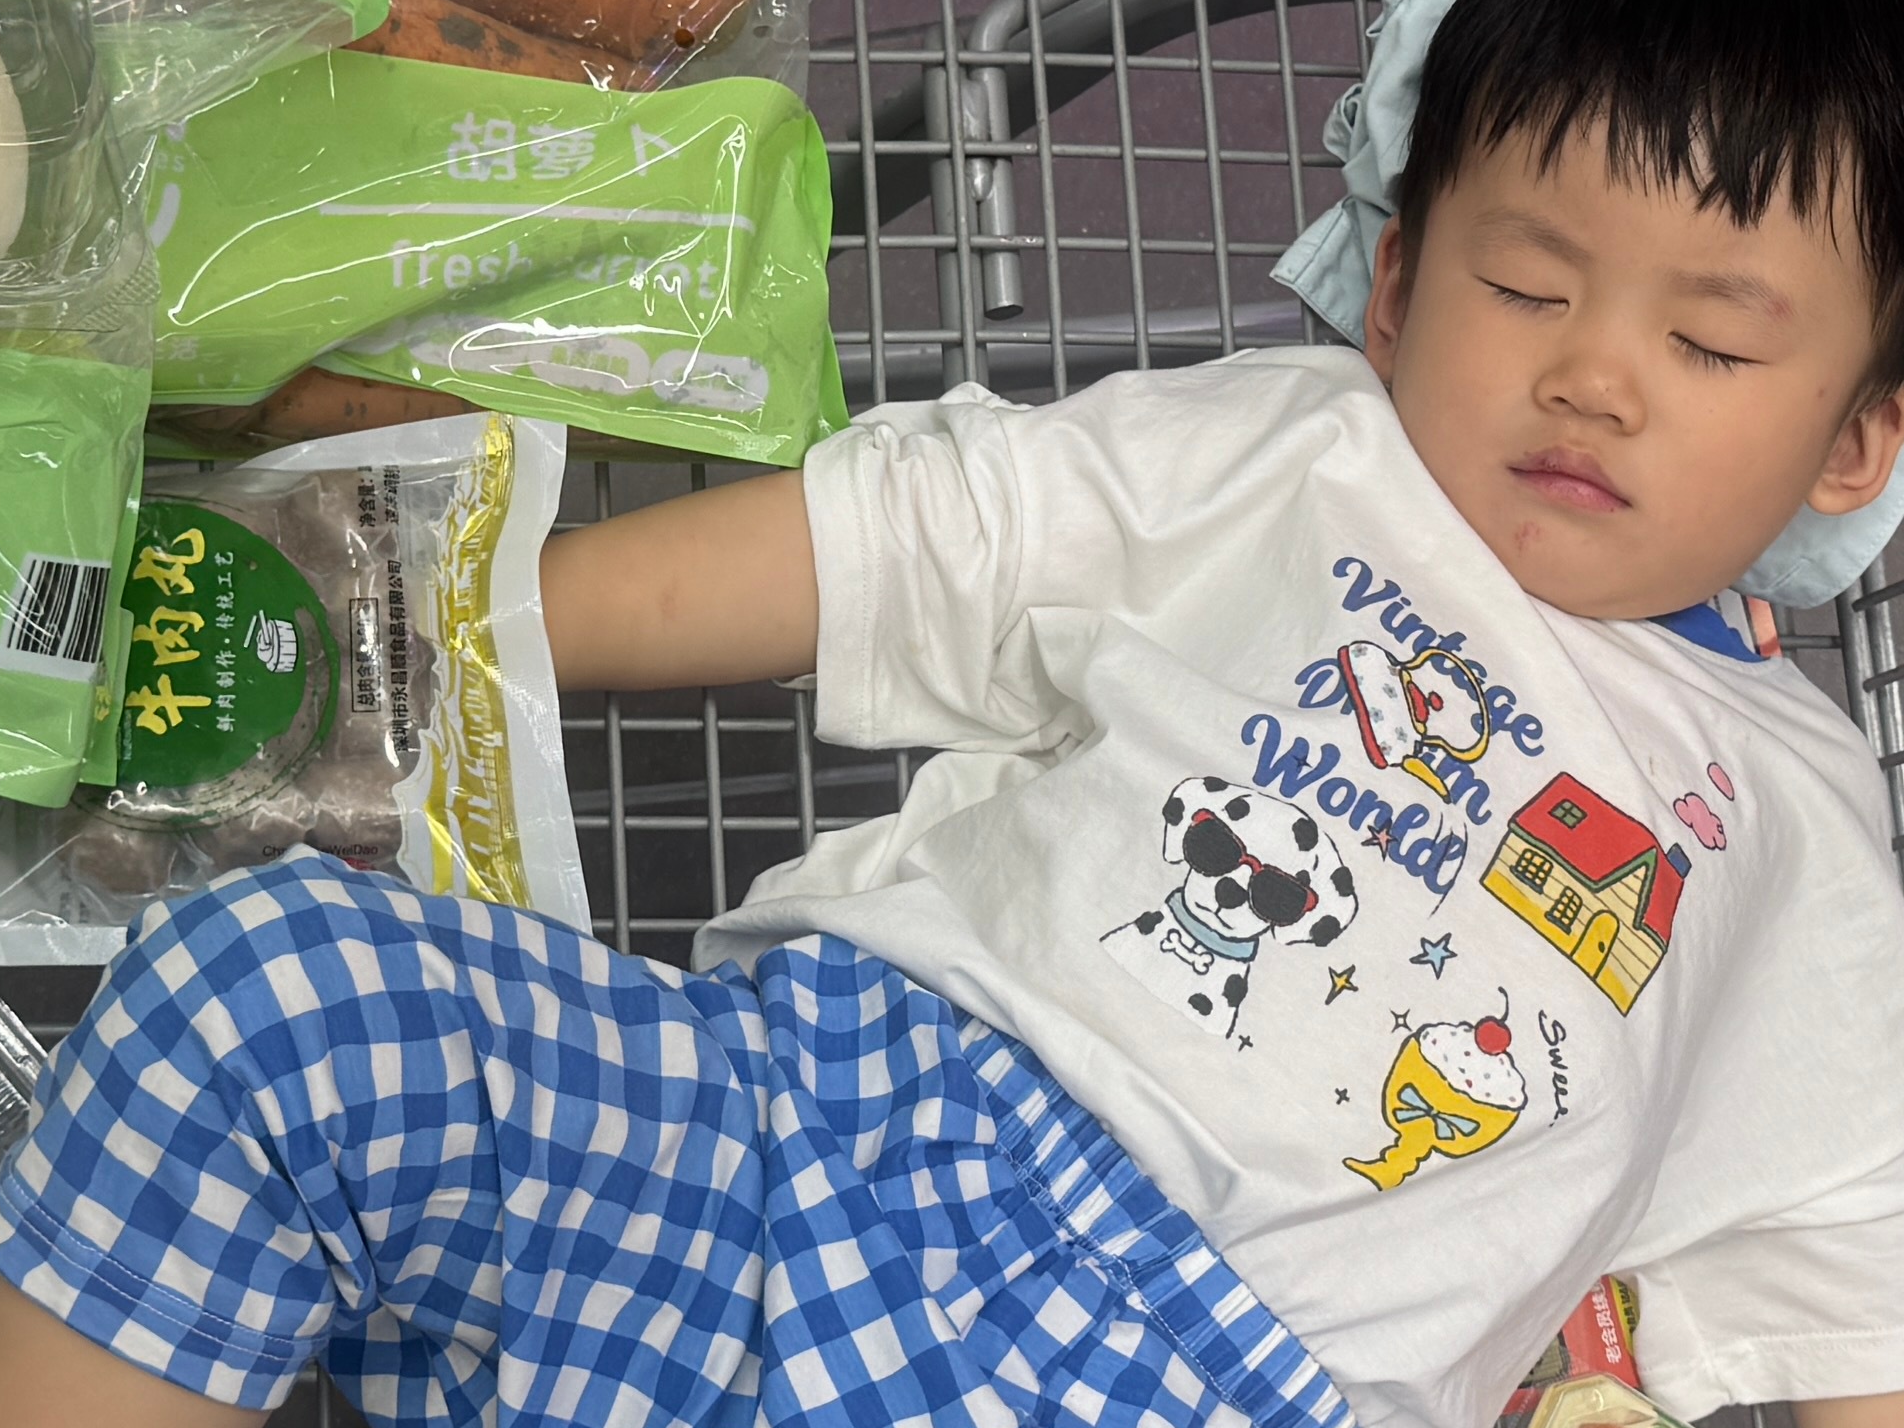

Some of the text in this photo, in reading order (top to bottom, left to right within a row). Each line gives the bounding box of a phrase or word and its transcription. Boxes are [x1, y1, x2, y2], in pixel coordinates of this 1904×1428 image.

[447, 112, 679, 182] 胡萝卜
[558, 252, 720, 300] arrot
[124, 527, 211, 734] 牛肉丸
[1332, 555, 1545, 757] Vintage
[1241, 713, 1467, 896] World
